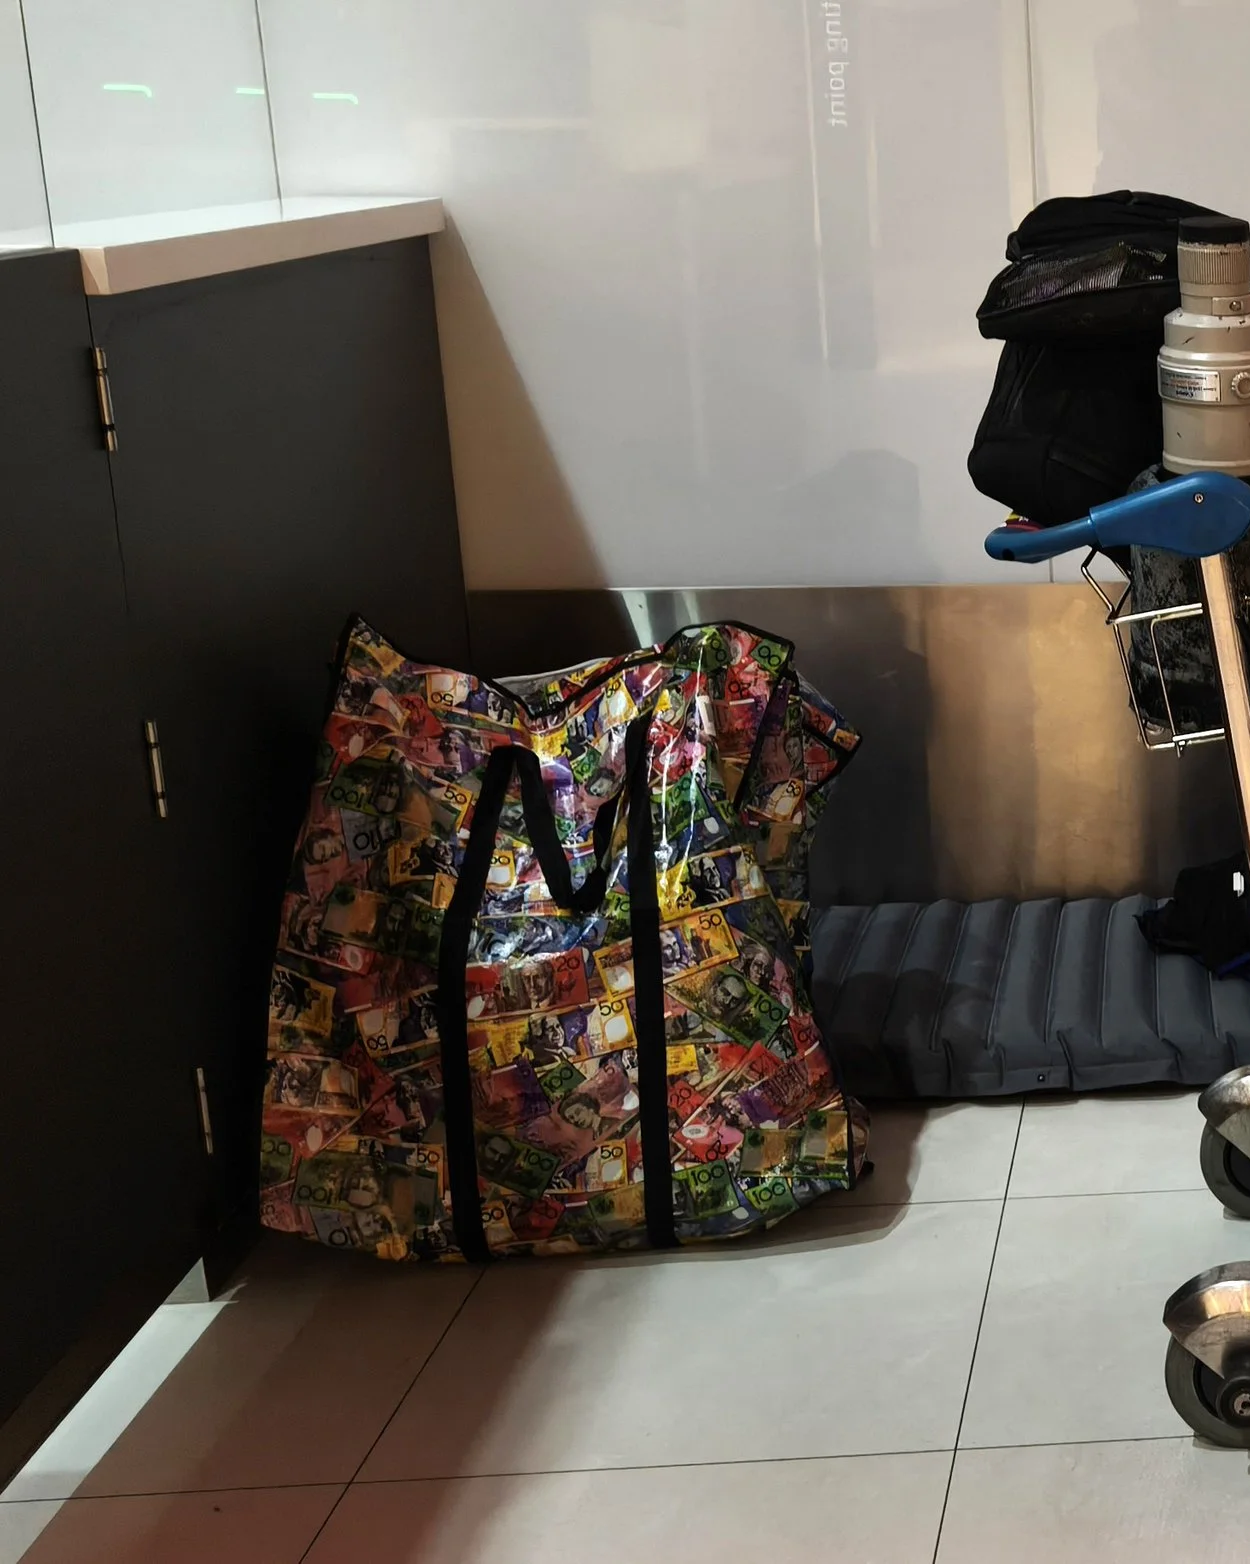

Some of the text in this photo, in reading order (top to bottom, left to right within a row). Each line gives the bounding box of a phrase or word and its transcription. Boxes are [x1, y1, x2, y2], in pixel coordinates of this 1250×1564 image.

[430, 692, 454, 707] 50
[443, 784, 468, 804] 50
[699, 913, 722, 931] 50
[556, 956, 581, 973] 20
[600, 1000, 624, 1016] 50
[753, 995, 783, 1022] 100
[544, 1066, 574, 1093] 100
[670, 1088, 692, 1105] 20
[417, 1148, 440, 1163] 50
[523, 1147, 554, 1171] 100
[600, 1145, 624, 1159] 50
[706, 1140, 729, 1161] 20
[690, 1163, 726, 1186] 100
[752, 1181, 786, 1205] 100
